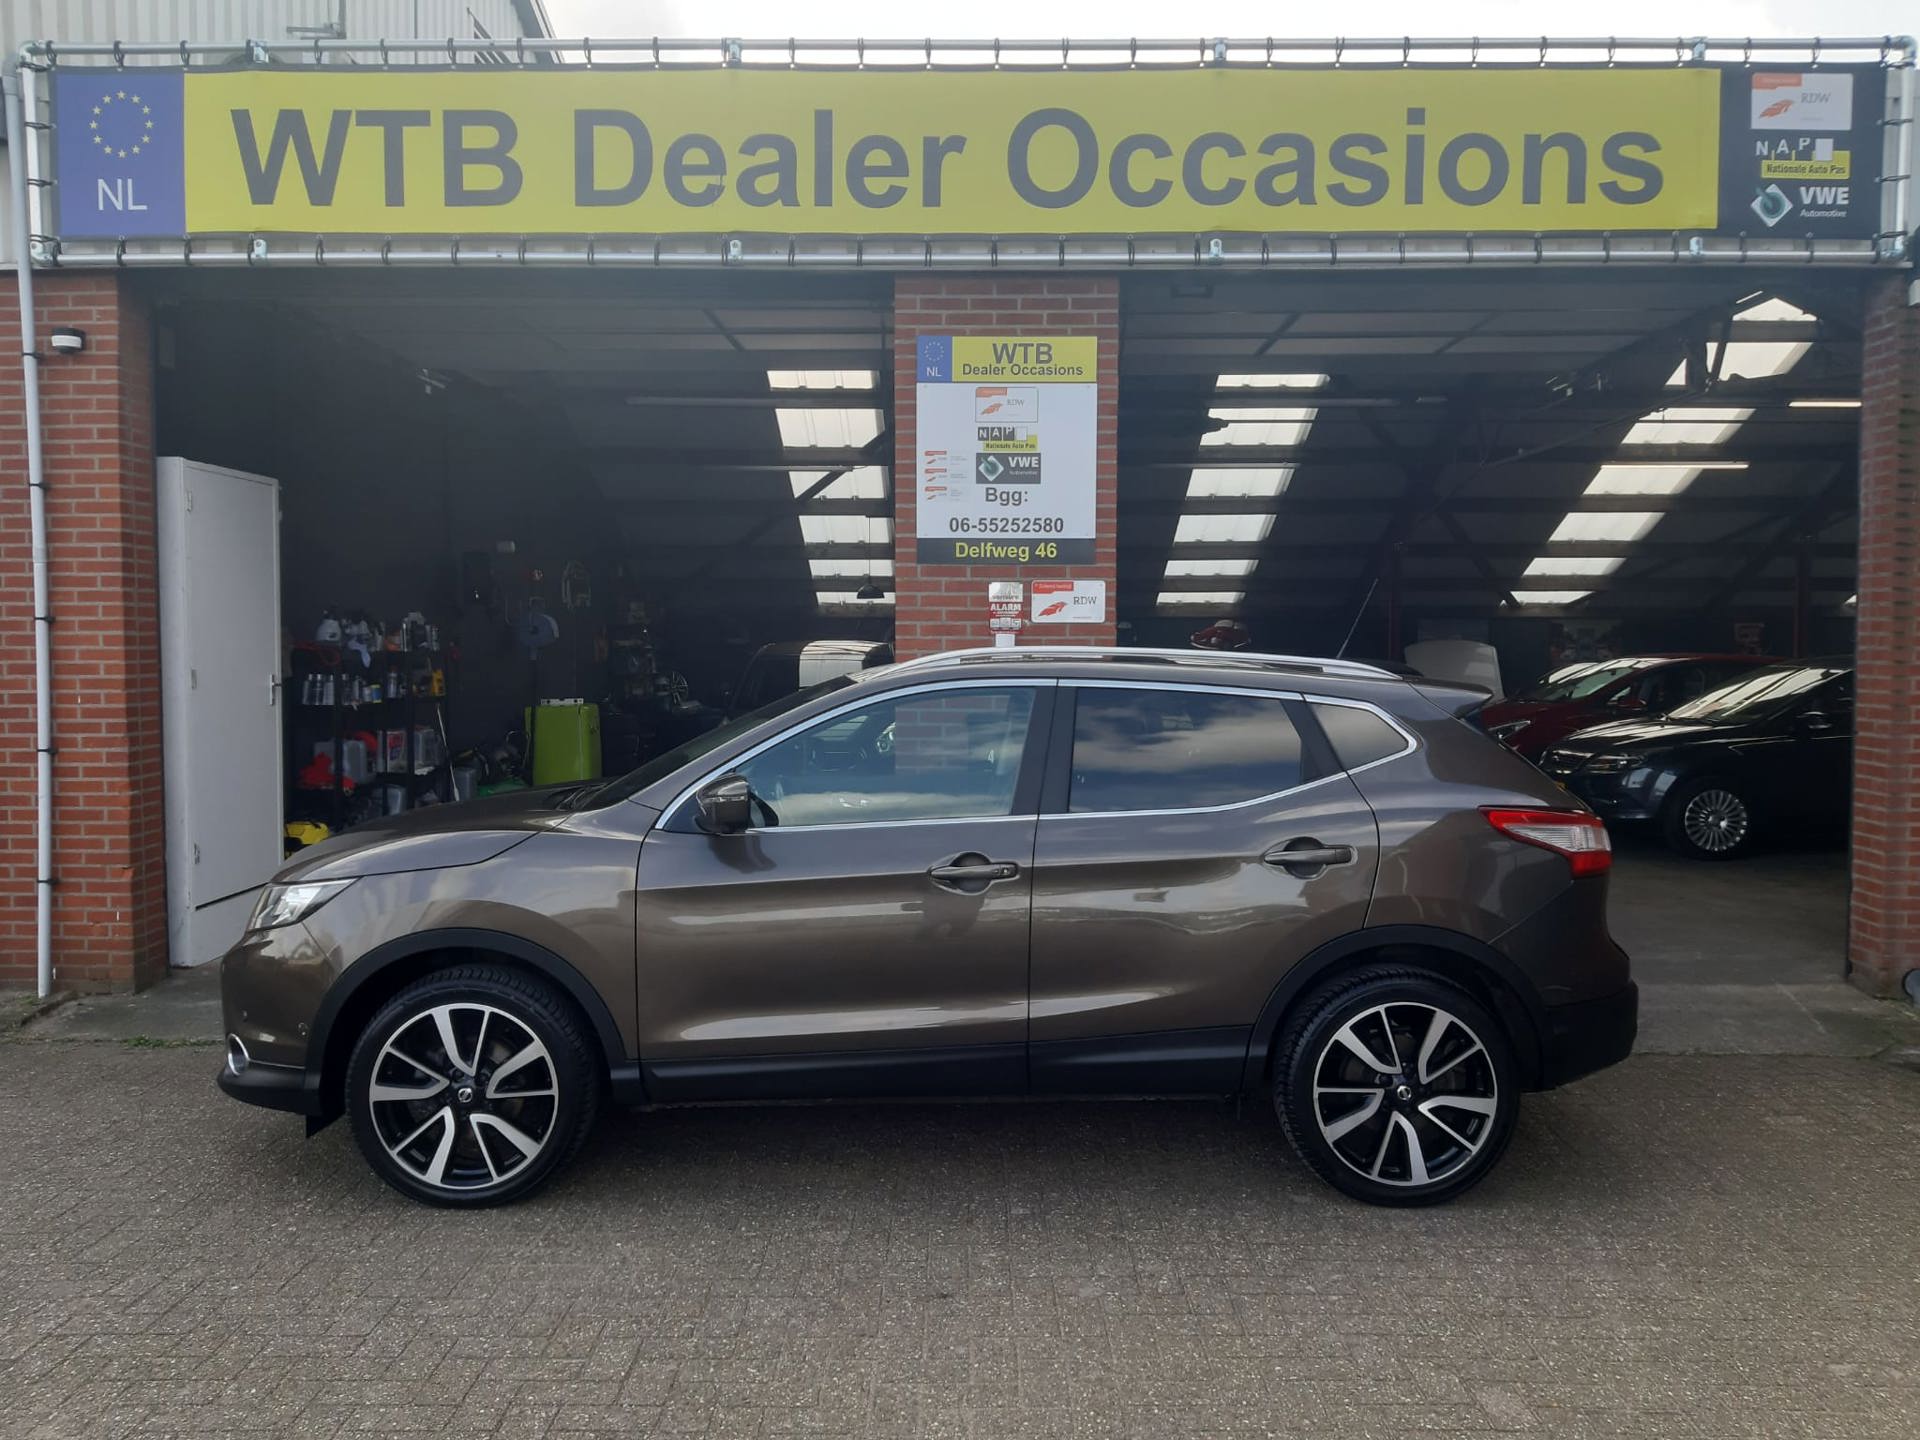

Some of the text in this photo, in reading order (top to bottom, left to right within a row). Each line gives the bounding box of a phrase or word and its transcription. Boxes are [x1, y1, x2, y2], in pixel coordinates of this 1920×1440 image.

[230, 106, 1664, 209] WTB Dealer Occasions
[97, 179, 148, 211] NL
[1800, 186, 1849, 205] VWE
[992, 342, 1054, 364] WTB
[926, 367, 942, 378] NL
[962, 363, 1084, 377] Dealer Occasions
[1008, 456, 1040, 468] VWE
[985, 487, 1029, 506] Bgg:
[949, 517, 1064, 533] 06-55252580
[955, 542, 1058, 562] Delfweg 46
[990, 603, 1022, 612] ALARM
[1073, 596, 1098, 606] RDW
